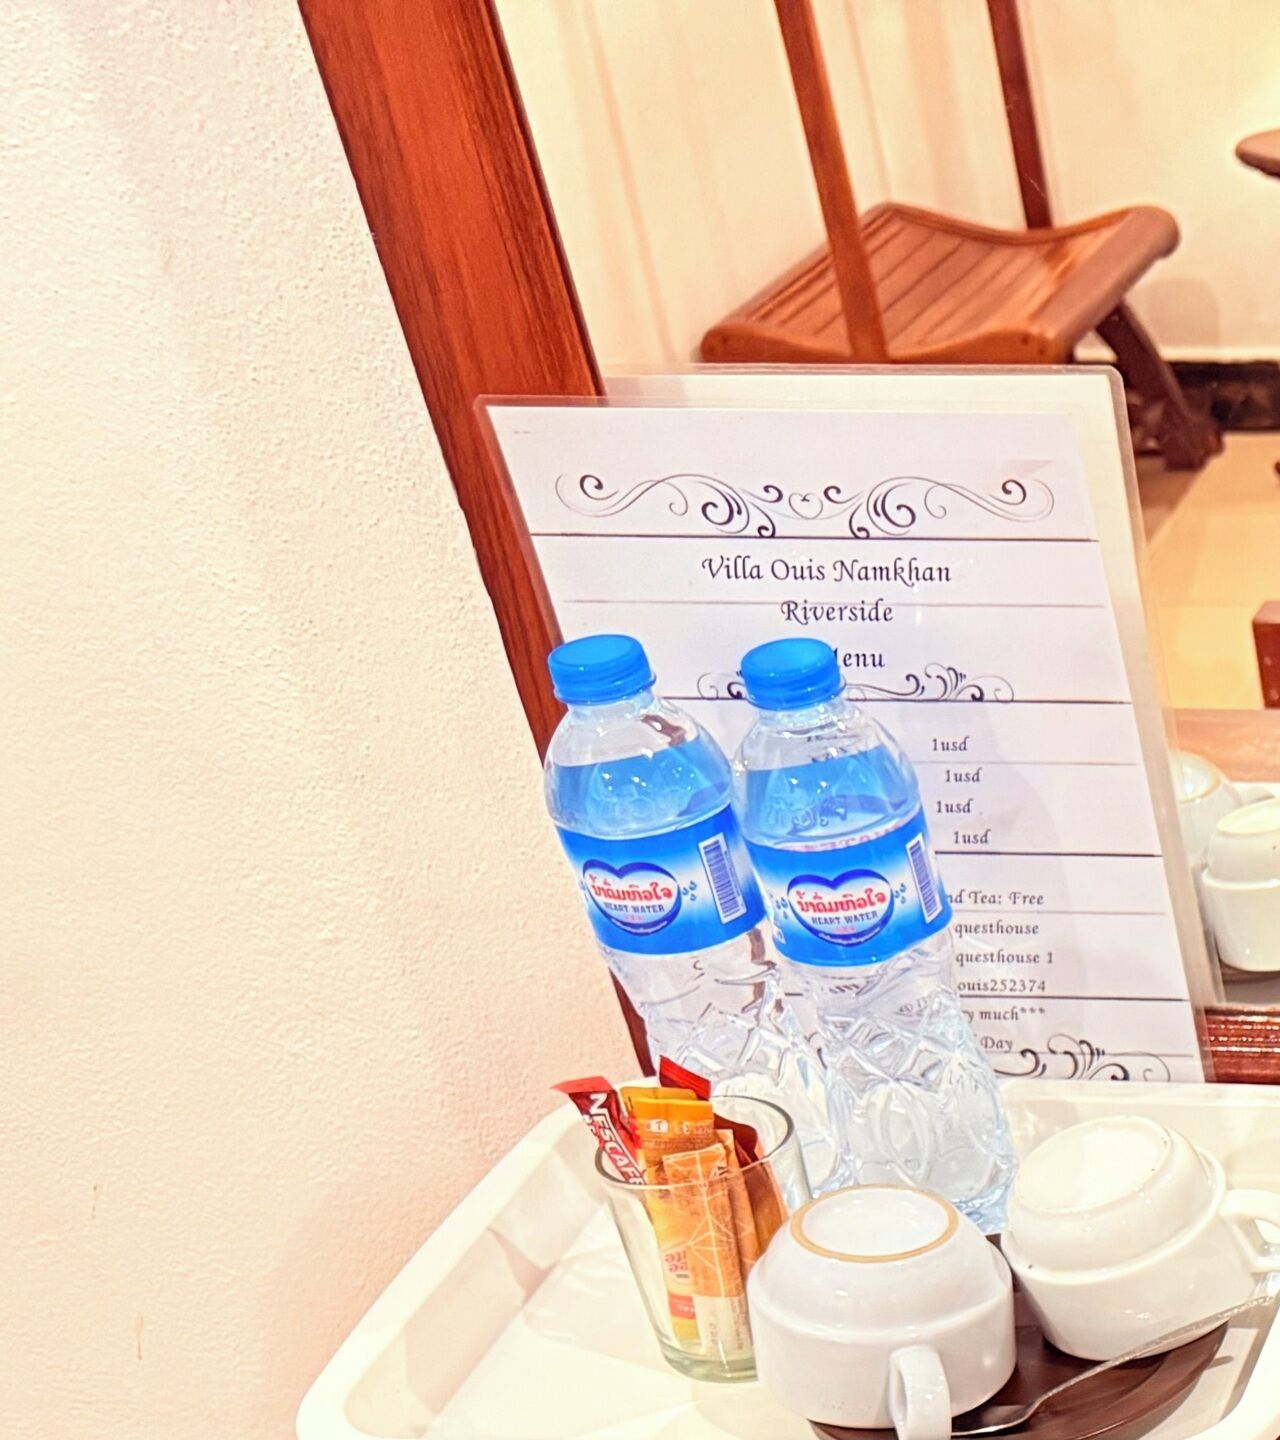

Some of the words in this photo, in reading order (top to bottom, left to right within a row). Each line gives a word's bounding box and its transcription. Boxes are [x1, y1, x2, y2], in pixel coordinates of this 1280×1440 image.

[701, 555, 764, 580] Villa
[770, 558, 826, 581] Ouis
[833, 557, 952, 587] Namkhan
[780, 598, 893, 625] Riverside
[834, 648, 886, 668] enu
[932, 736, 970, 751] 1usd
[945, 767, 982, 782] 1usd
[936, 798, 973, 813] 1usd
[953, 829, 991, 844] 1usd
[968, 891, 1002, 905] Tea:
[1009, 891, 1045, 905] Free
[633, 903, 665, 913] WATER
[811, 915, 841, 926] HEART
[844, 910, 879, 925] WATER
[980, 1036, 1013, 1052] Day
